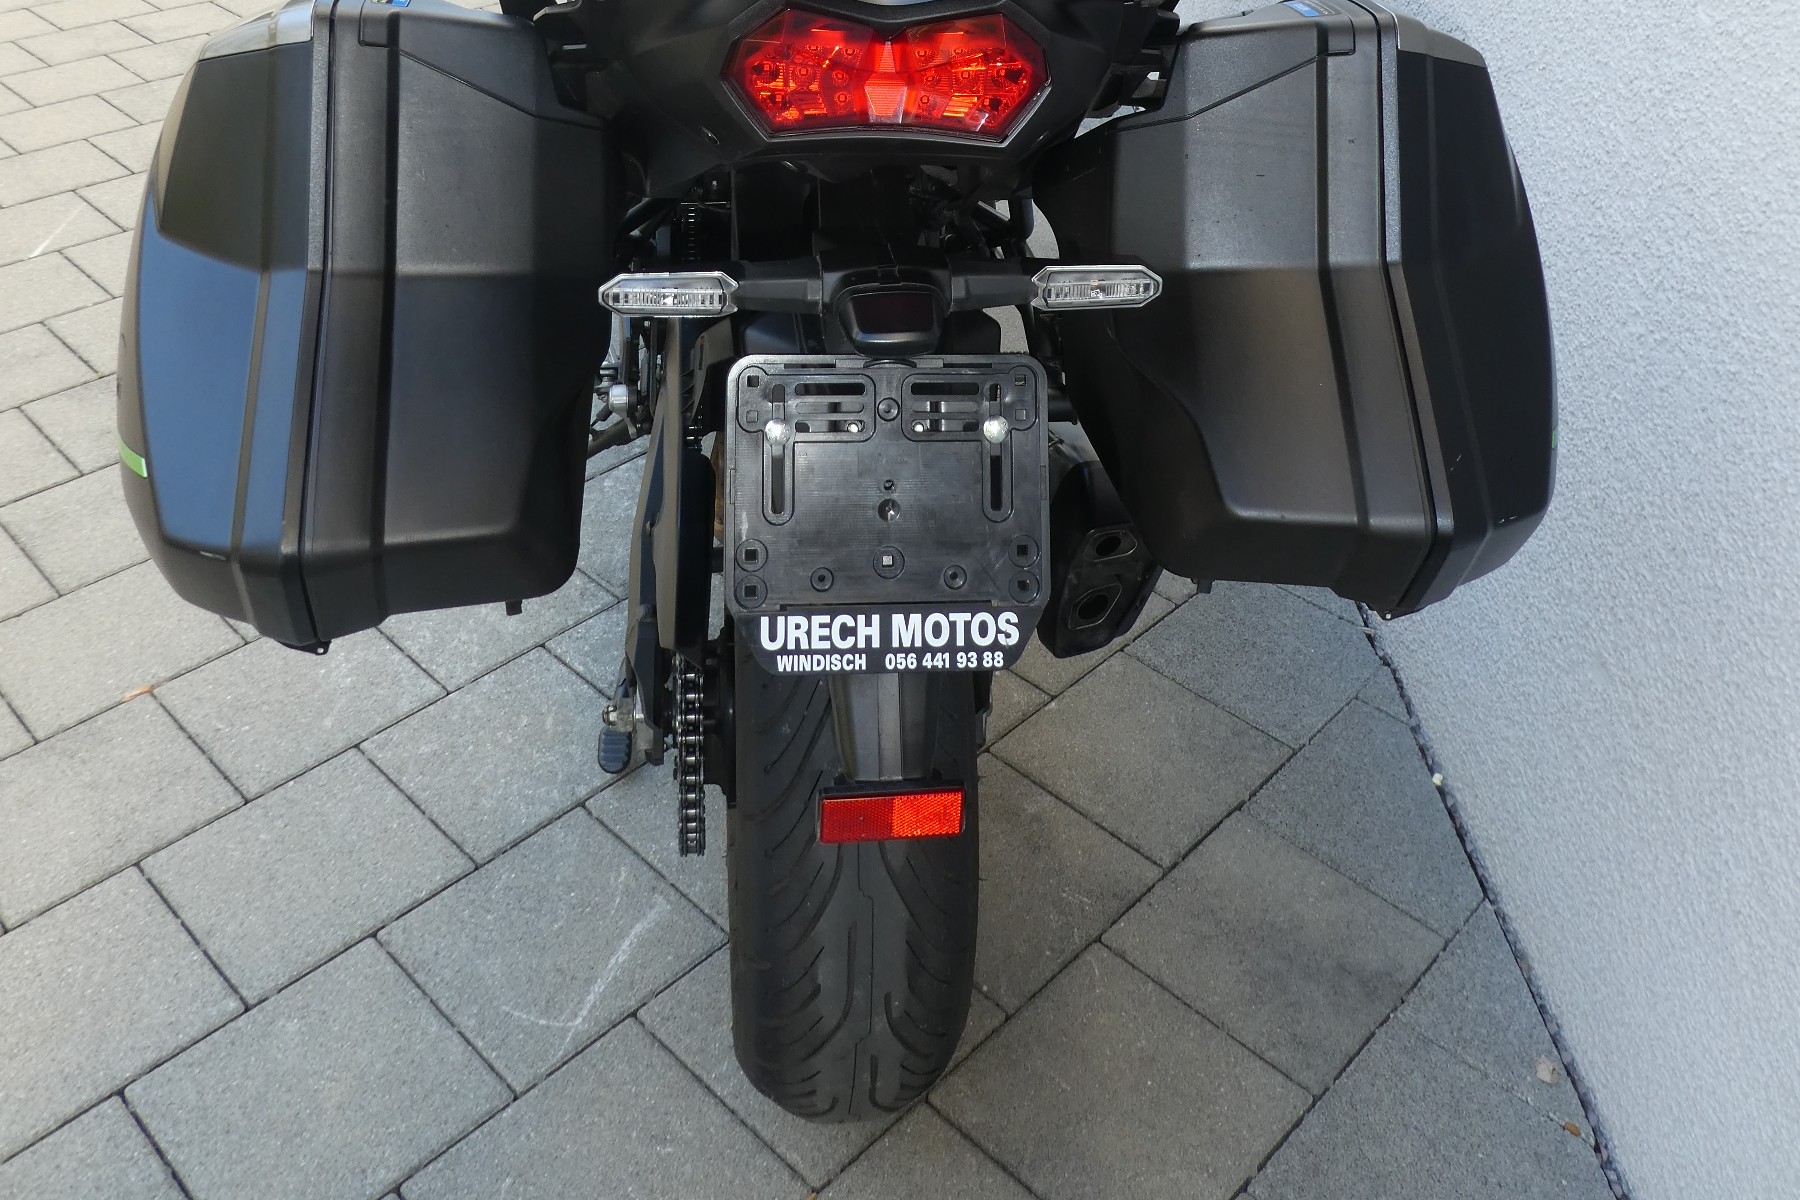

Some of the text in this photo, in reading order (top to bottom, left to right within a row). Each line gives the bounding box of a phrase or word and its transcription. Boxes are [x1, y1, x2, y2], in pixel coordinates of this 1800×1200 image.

[760, 611, 1020, 651] URECH MOTOS
[777, 651, 1004, 672] WINDISCH 056 441 93 88
